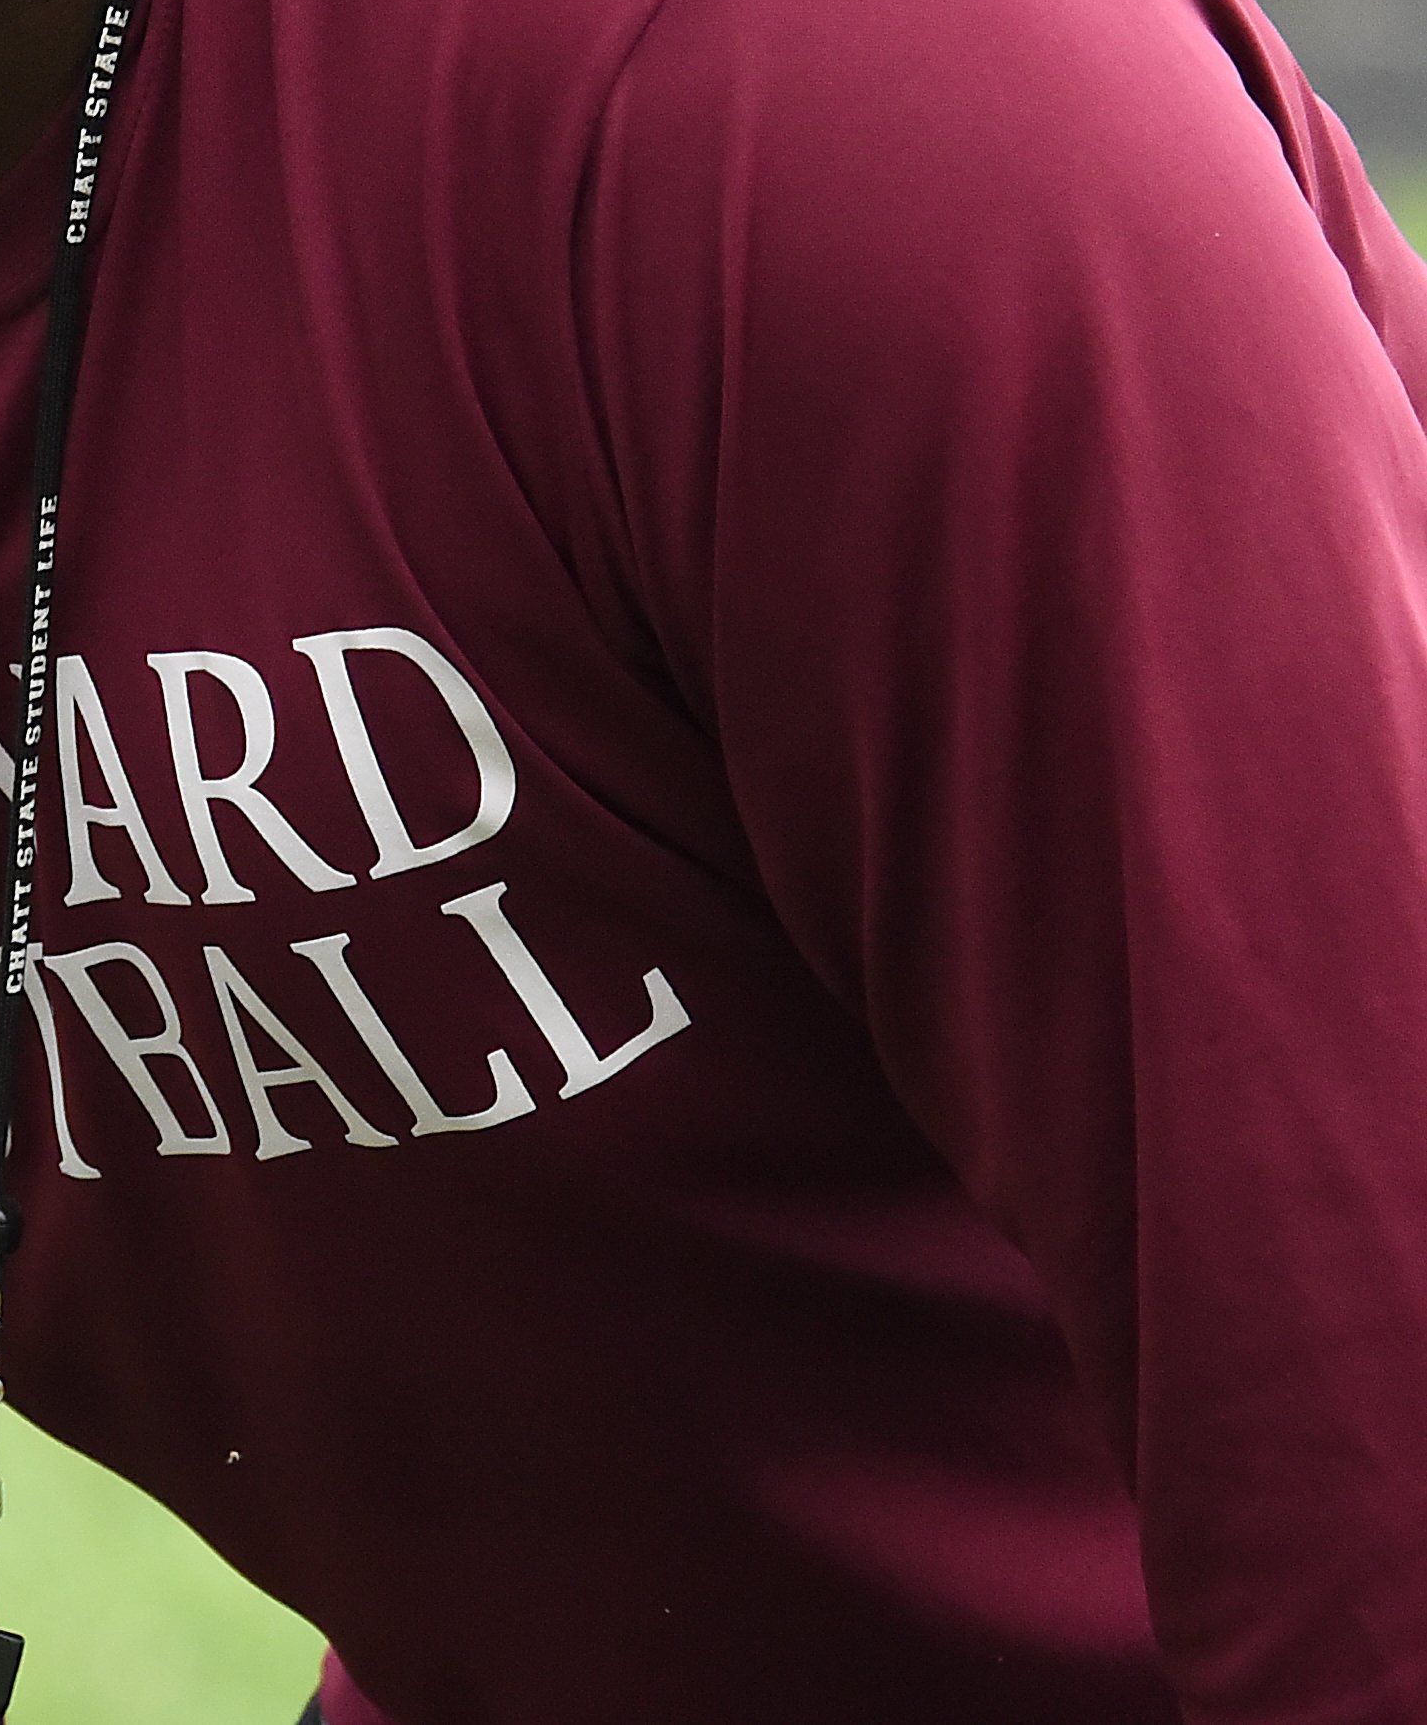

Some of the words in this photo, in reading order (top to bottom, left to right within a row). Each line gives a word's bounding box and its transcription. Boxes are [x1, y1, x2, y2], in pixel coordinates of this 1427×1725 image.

[66, 127, 102, 244] CHATT
[84, 5, 130, 118] STATE
[36, 495, 58, 572] LIFE
[24, 584, 51, 746] STUDENT
[16, 756, 39, 868] STATE
[5, 879, 32, 994] CHATT
